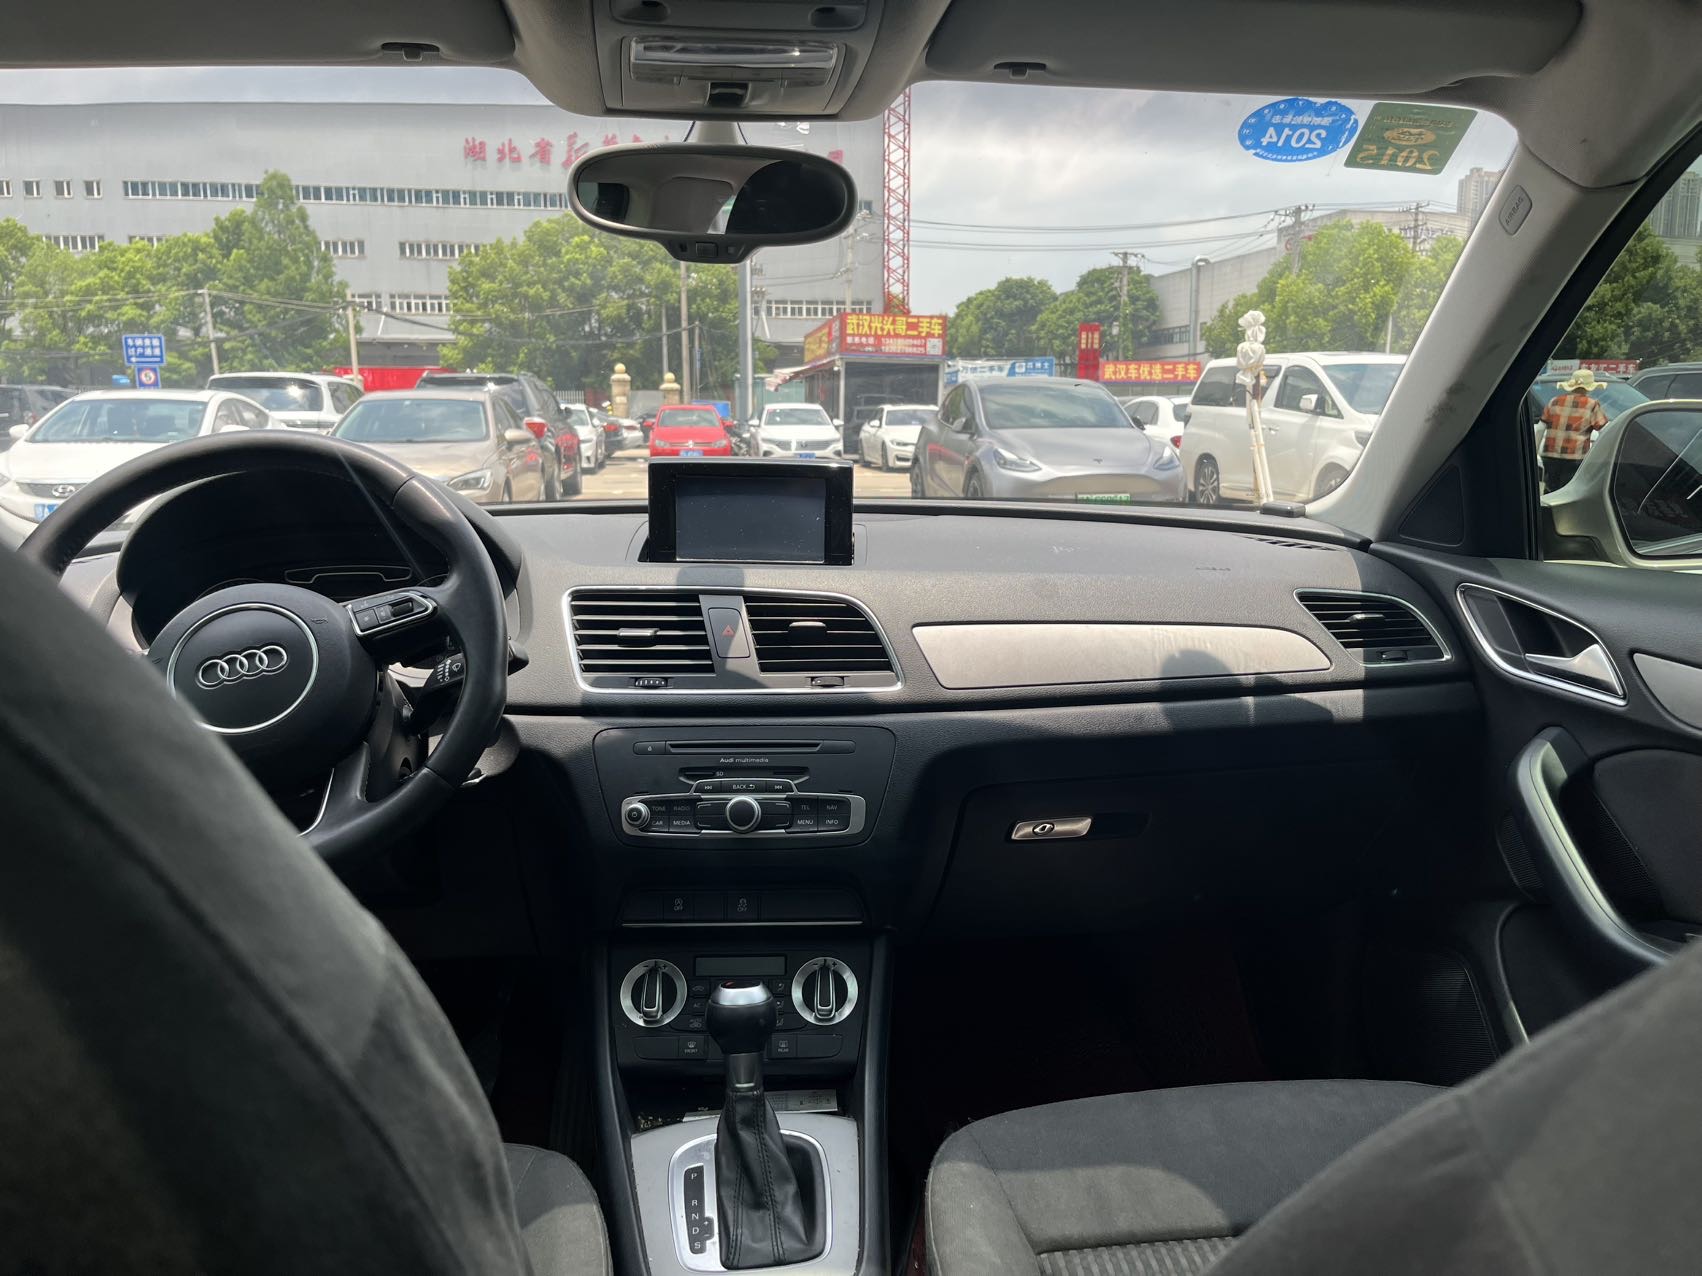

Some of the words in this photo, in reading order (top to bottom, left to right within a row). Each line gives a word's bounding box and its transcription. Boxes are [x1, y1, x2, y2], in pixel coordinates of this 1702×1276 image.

[846, 314, 943, 337] 武汉光头哥二手车
[1104, 363, 1198, 380] 武汉车优选二手车
[694, 1241, 701, 1249] S
